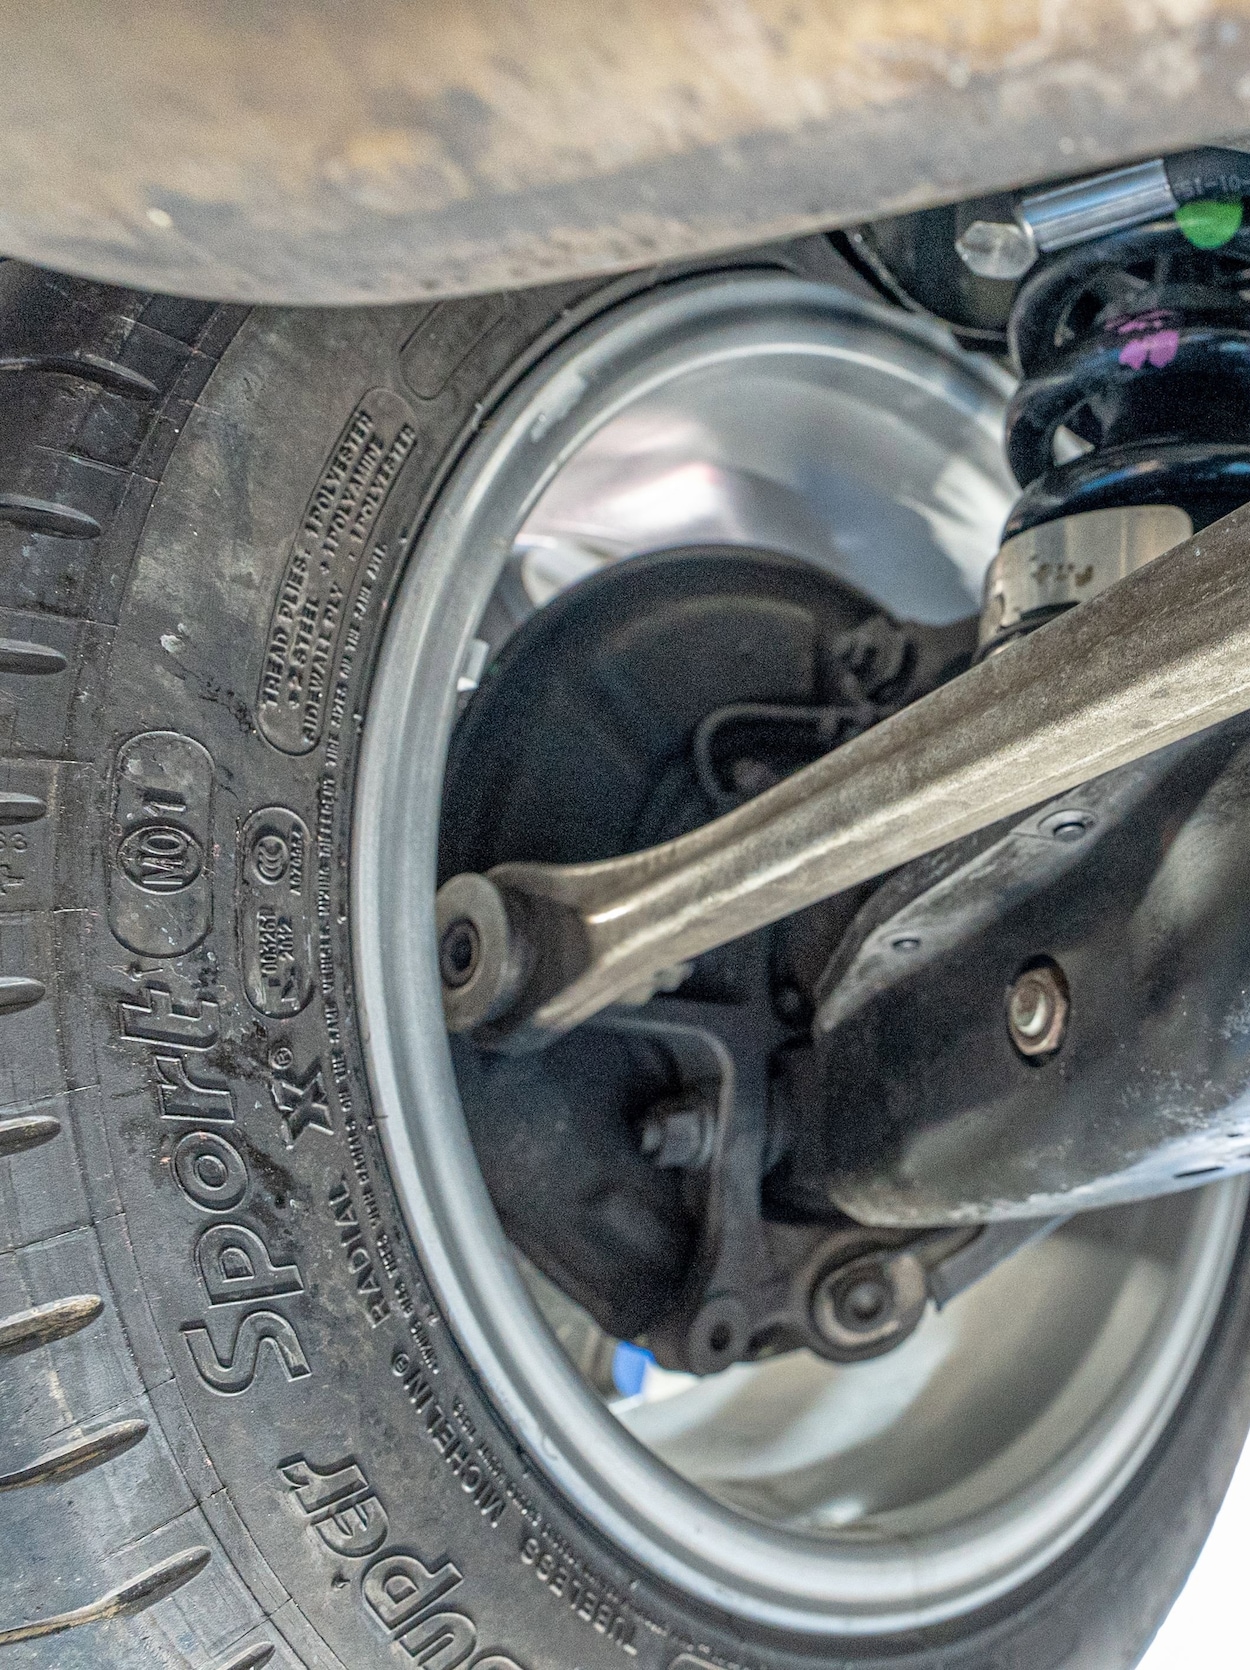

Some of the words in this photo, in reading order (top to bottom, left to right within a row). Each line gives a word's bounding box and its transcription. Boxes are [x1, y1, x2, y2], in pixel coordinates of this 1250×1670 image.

[289, 597, 319, 668] STEEL
[300, 629, 333, 743] SIDEWALL
[322, 582, 345, 628] PLY
[264, 628, 290, 706] TREAD
[139, 834, 186, 884] MO
[277, 922, 295, 961] 2012
[324, 1004, 340, 1043] SAME
[331, 1055, 348, 1084] THE
[338, 1090, 353, 1112] ON
[344, 1120, 371, 1184] RADIALS
[120, 988, 313, 1396] Sport
[361, 1189, 382, 1228] WITH
[330, 1174, 391, 1328] RADIAL
[520, 1537, 639, 1655] TUBELESS
